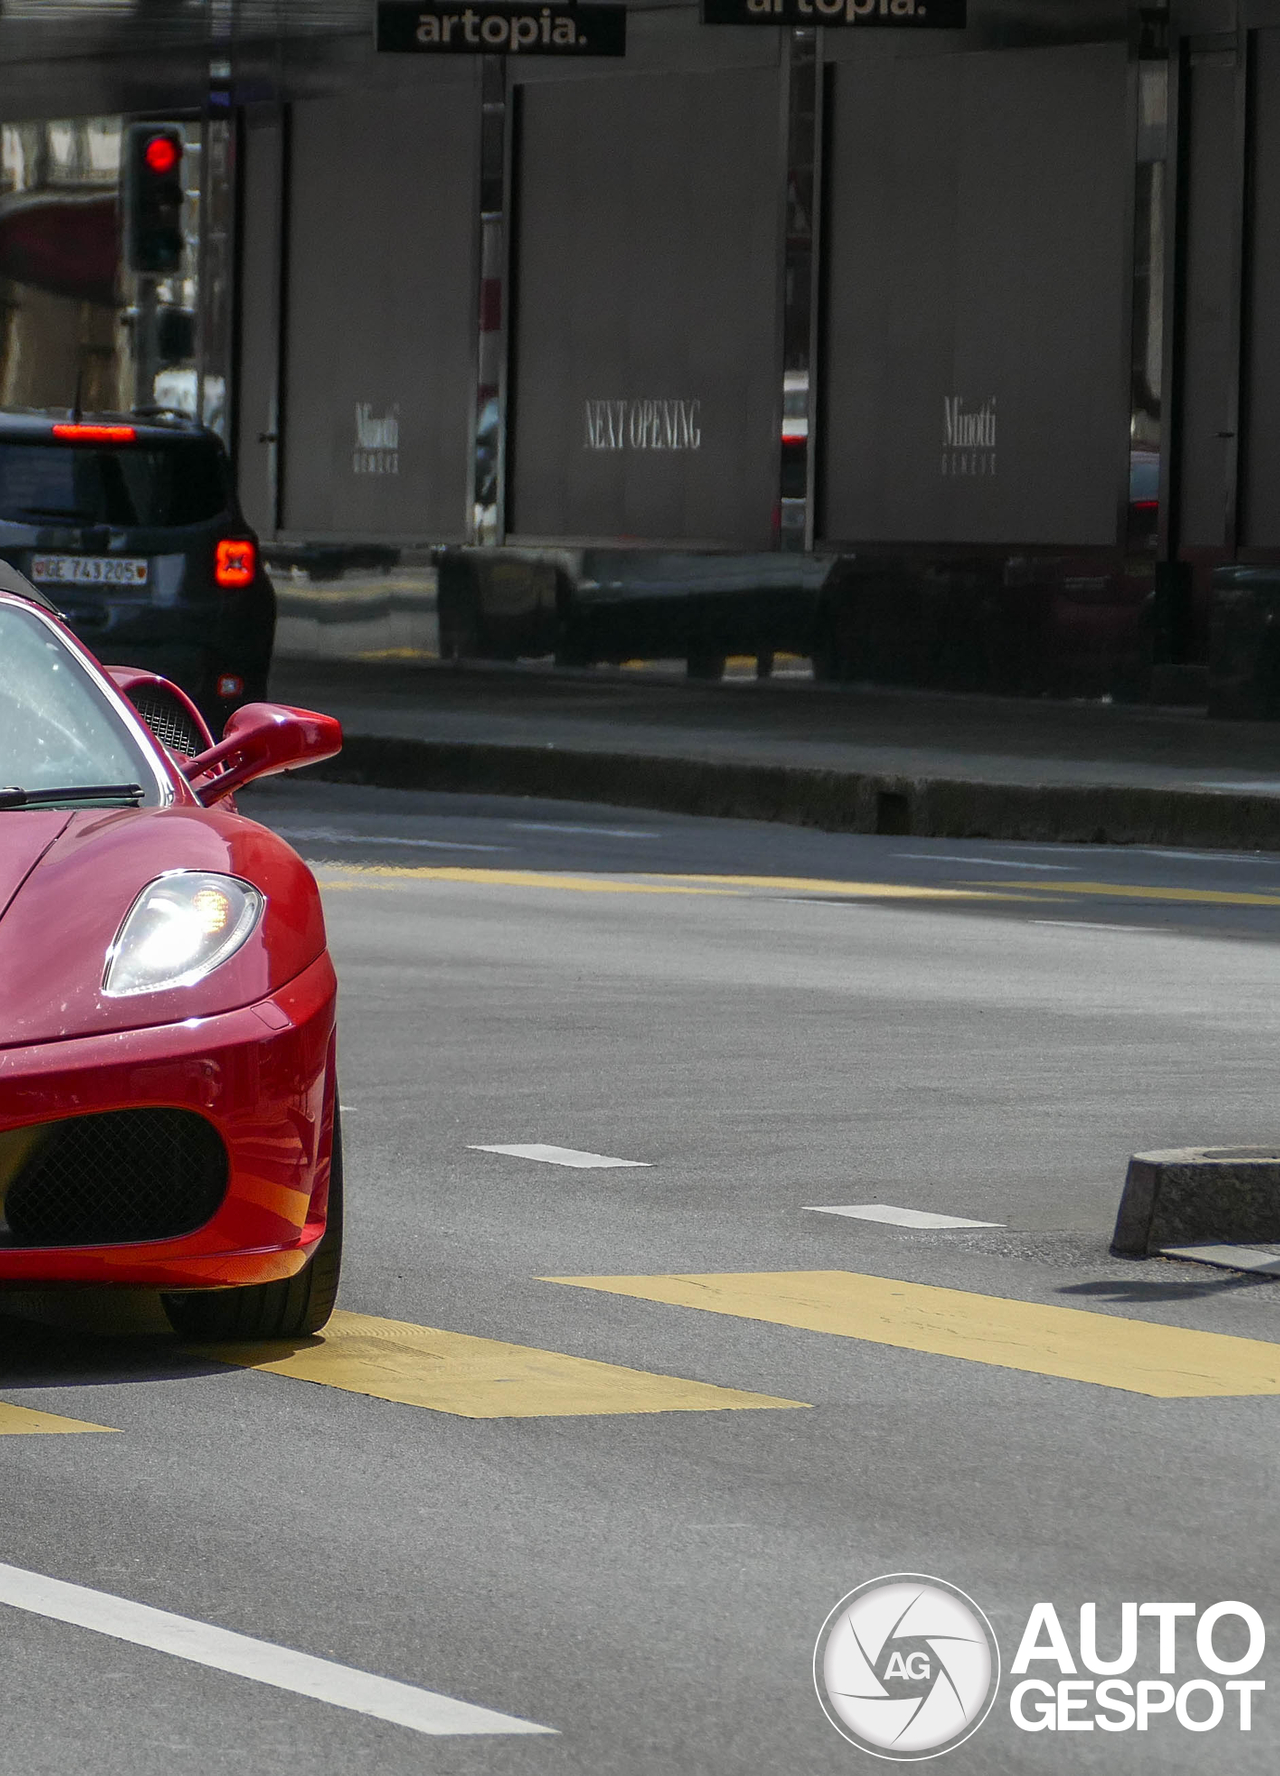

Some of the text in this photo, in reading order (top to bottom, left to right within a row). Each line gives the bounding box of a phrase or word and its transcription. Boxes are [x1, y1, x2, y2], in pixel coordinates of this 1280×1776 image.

[416, 7, 588, 51] artopia.
[584, 399, 701, 449] NEXT OPENING
[46, 559, 135, 580] GE 743205
